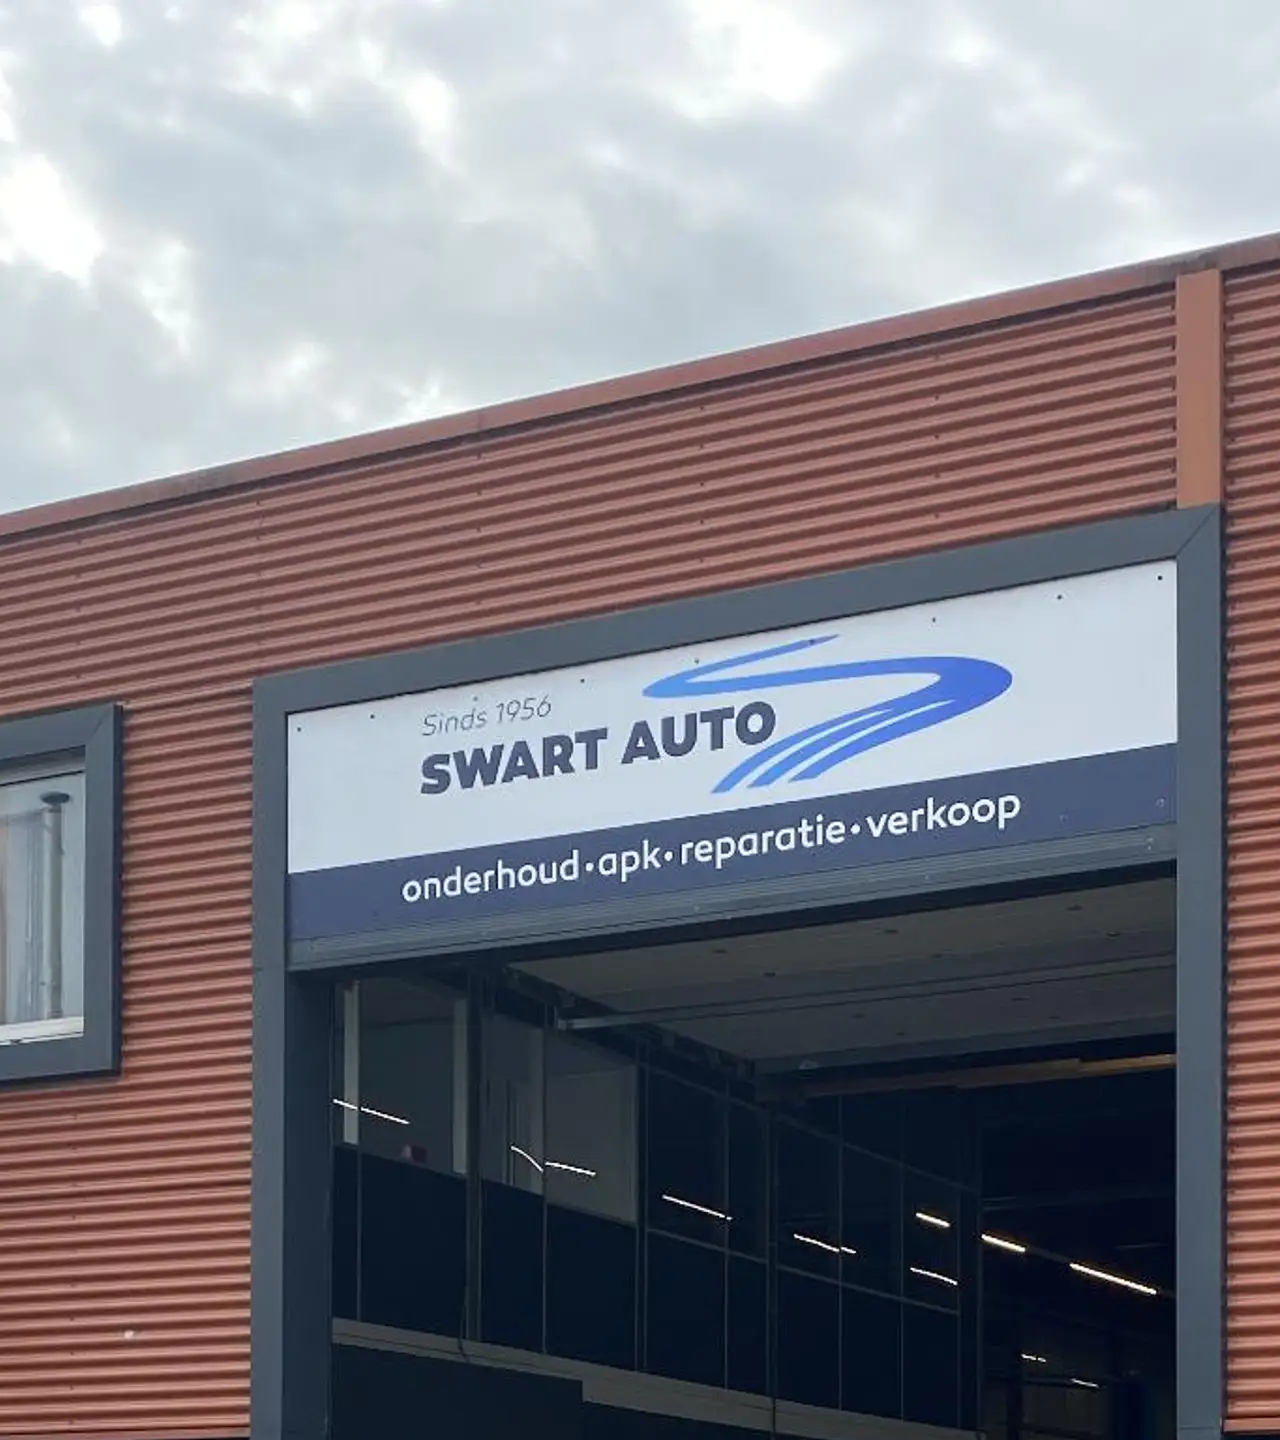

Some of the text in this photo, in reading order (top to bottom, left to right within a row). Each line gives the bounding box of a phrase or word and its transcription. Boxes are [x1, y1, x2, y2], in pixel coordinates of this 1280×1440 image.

[420, 701, 777, 796] SWART AUTO
[421, 694, 552, 737] Sinds 1956
[401, 794, 1022, 903] onderhoud apk reparatie verkoop
